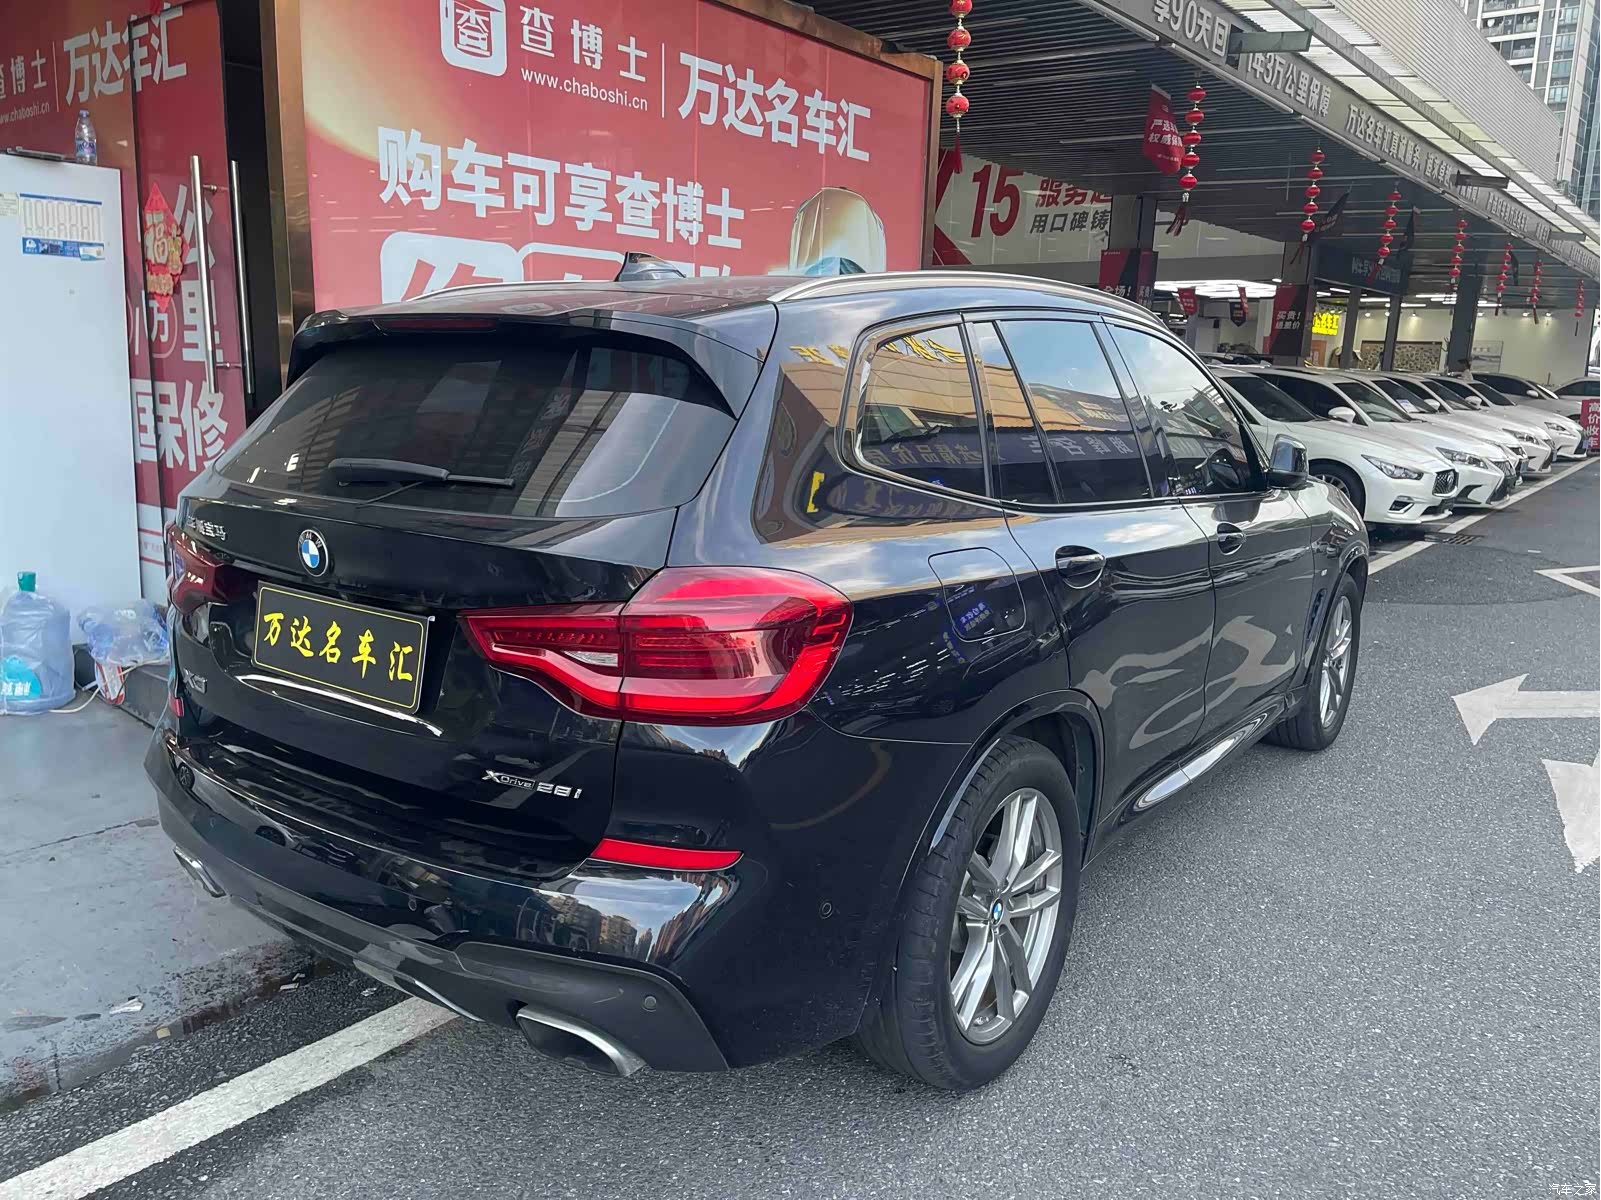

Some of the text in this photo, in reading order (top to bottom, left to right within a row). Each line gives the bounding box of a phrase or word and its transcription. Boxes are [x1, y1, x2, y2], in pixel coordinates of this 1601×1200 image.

[519, 4, 648, 83] 查博士
[520, 67, 649, 112] www.chaboshi.cn
[677, 50, 872, 162] 万达名车汇
[376, 125, 746, 251] 购车可享查博士
[970, 164, 1025, 238] 15
[1029, 208, 1112, 235] 用口碑铸
[262, 612, 414, 683] 万达名车汇
